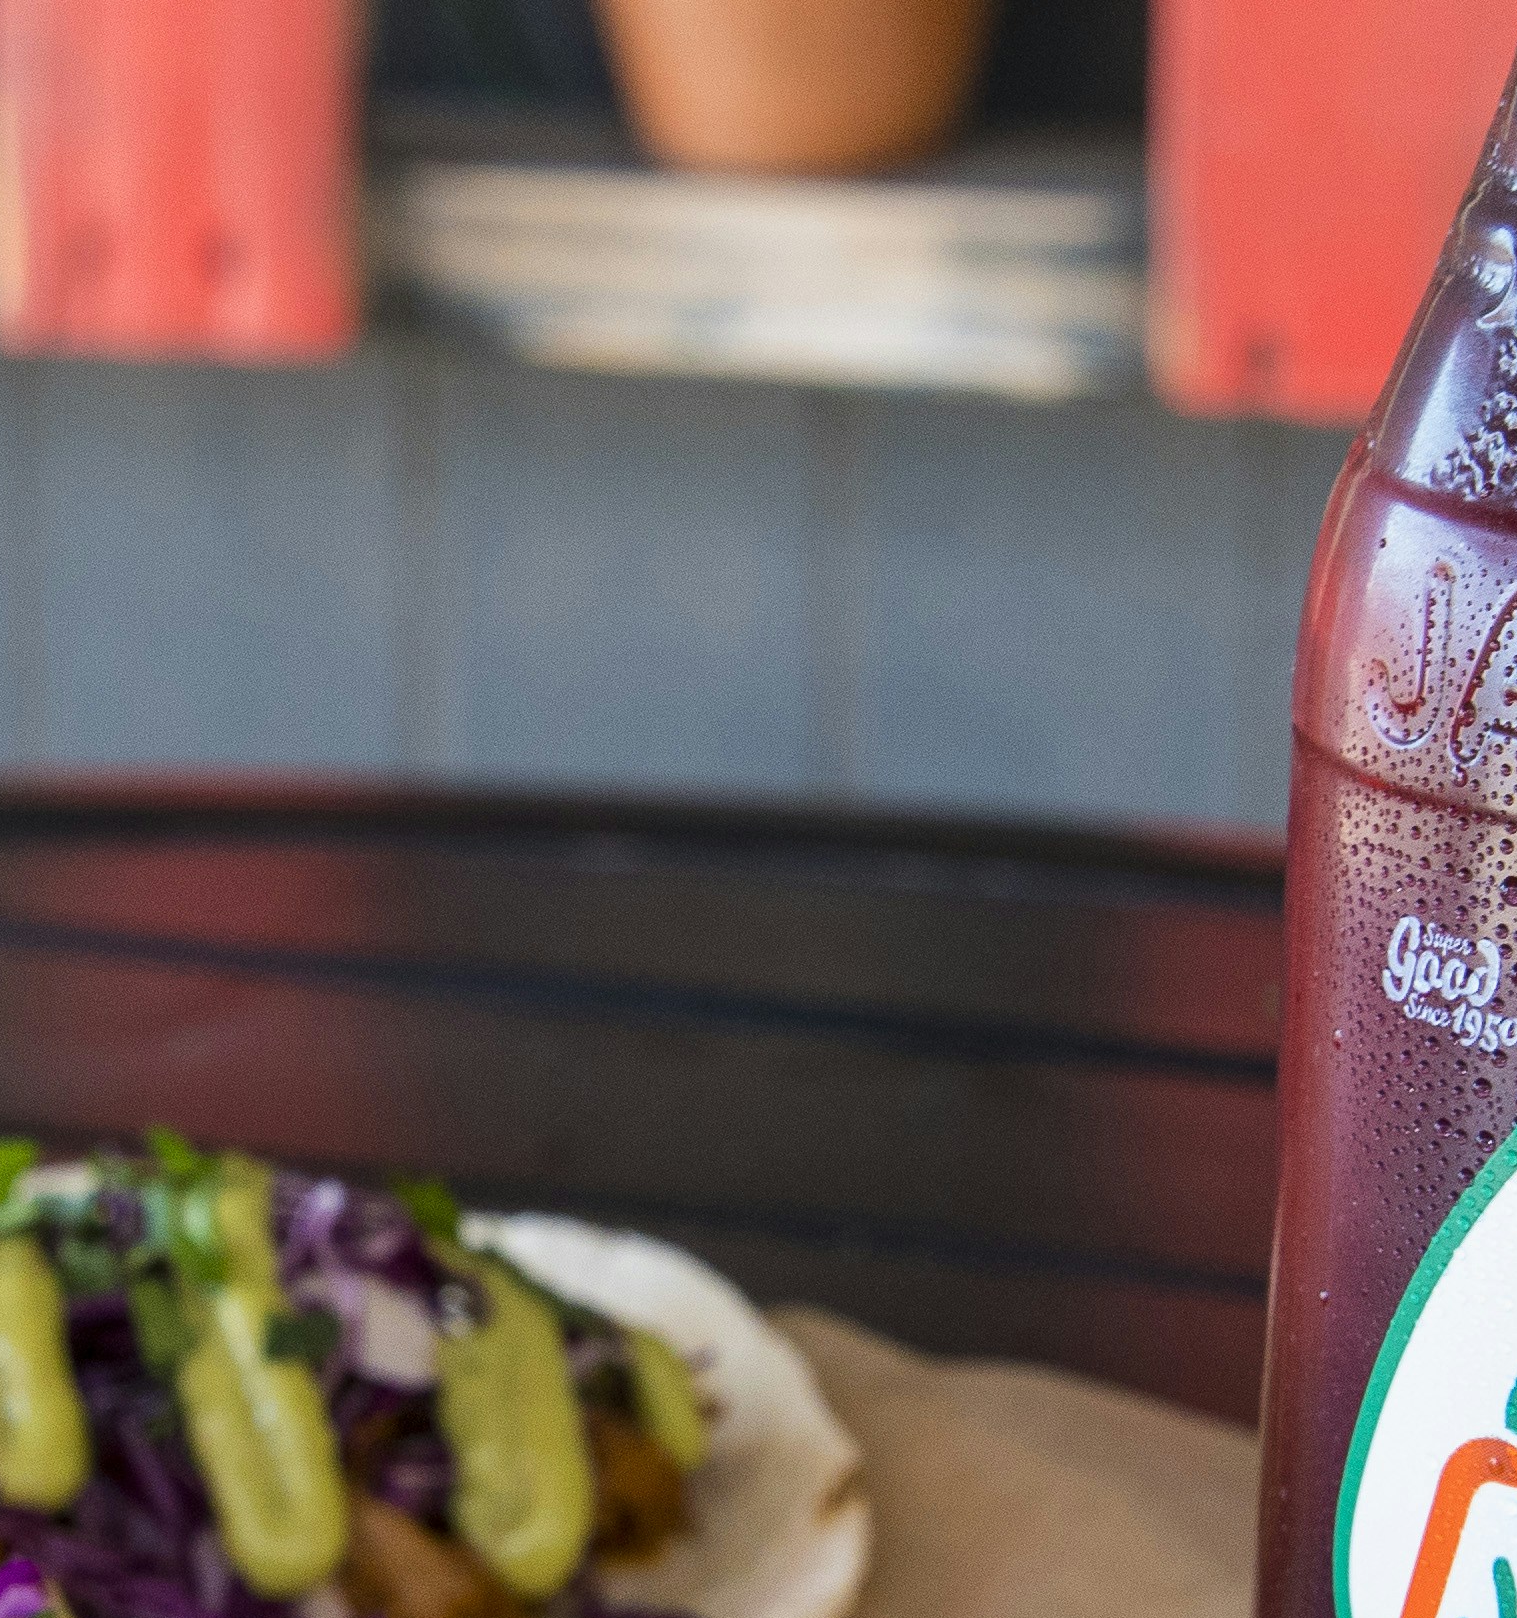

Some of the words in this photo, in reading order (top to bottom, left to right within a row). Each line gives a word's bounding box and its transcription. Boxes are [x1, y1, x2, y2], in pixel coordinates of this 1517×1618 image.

[1423, 922, 1474, 956] Super
[1382, 915, 1501, 1008] Good
[1403, 992, 1452, 1028] Since
